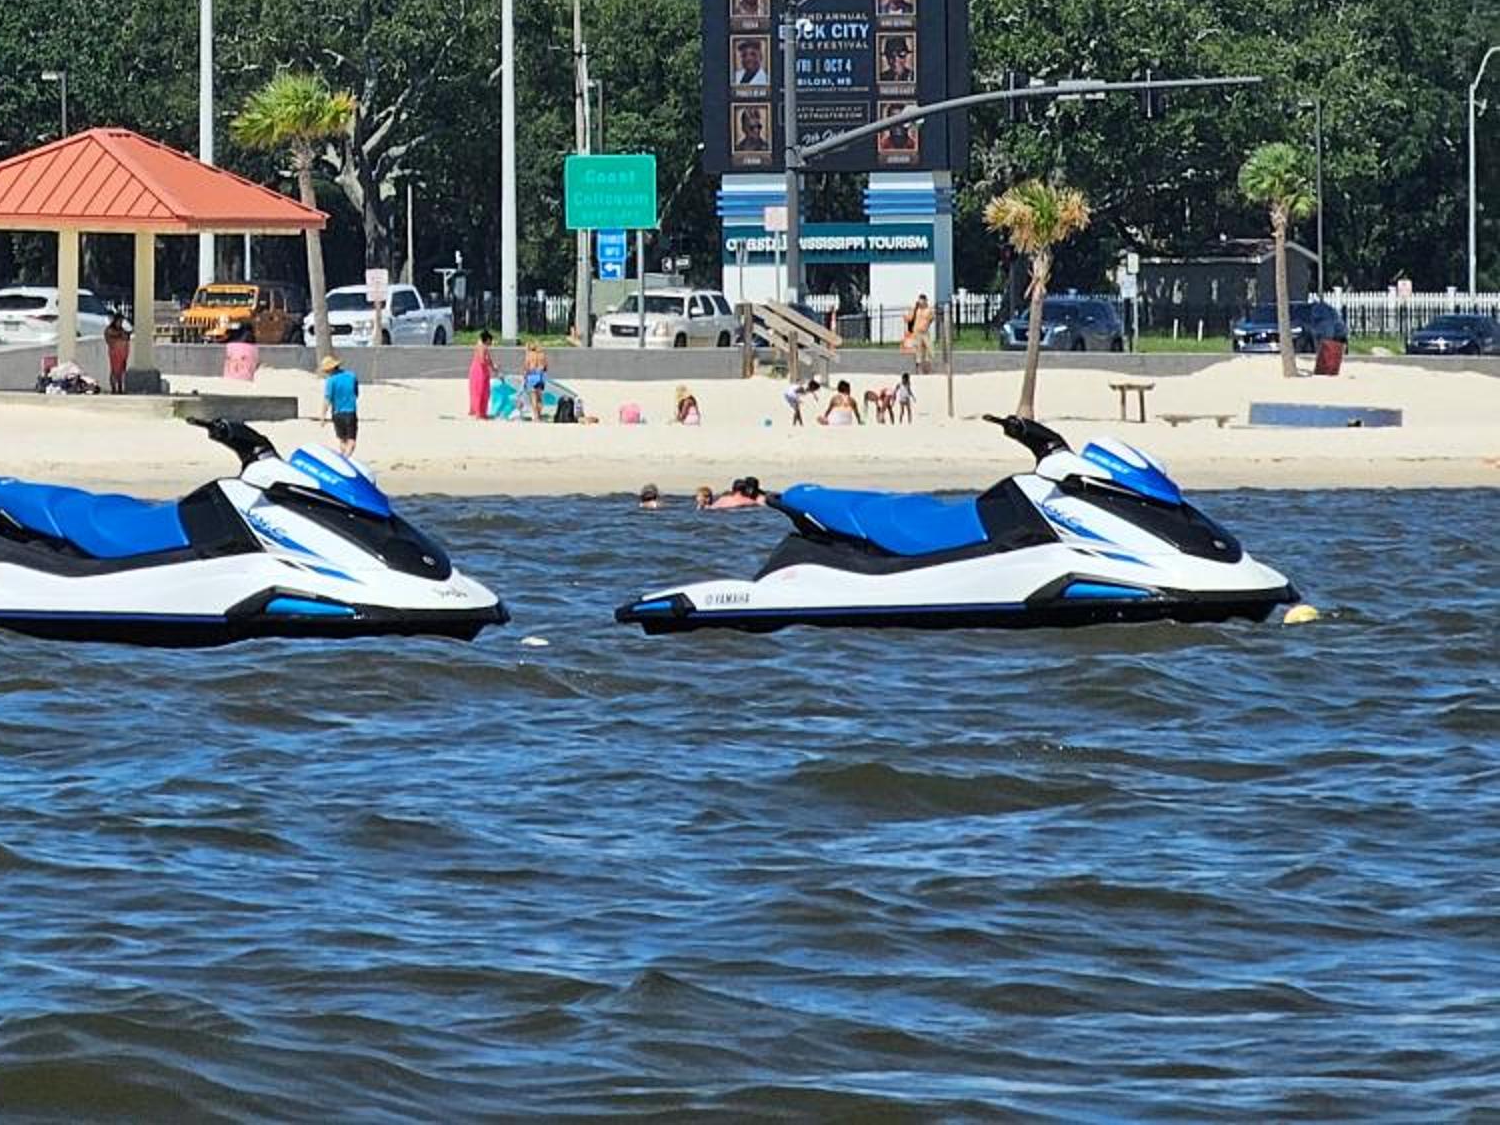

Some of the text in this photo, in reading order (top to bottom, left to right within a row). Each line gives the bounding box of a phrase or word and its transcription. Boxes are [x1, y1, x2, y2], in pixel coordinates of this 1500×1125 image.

[831, 22, 870, 40] CITY
[823, 58, 844, 73] OCT
[845, 58, 853, 74] 4
[868, 235, 929, 250] TOURISM
